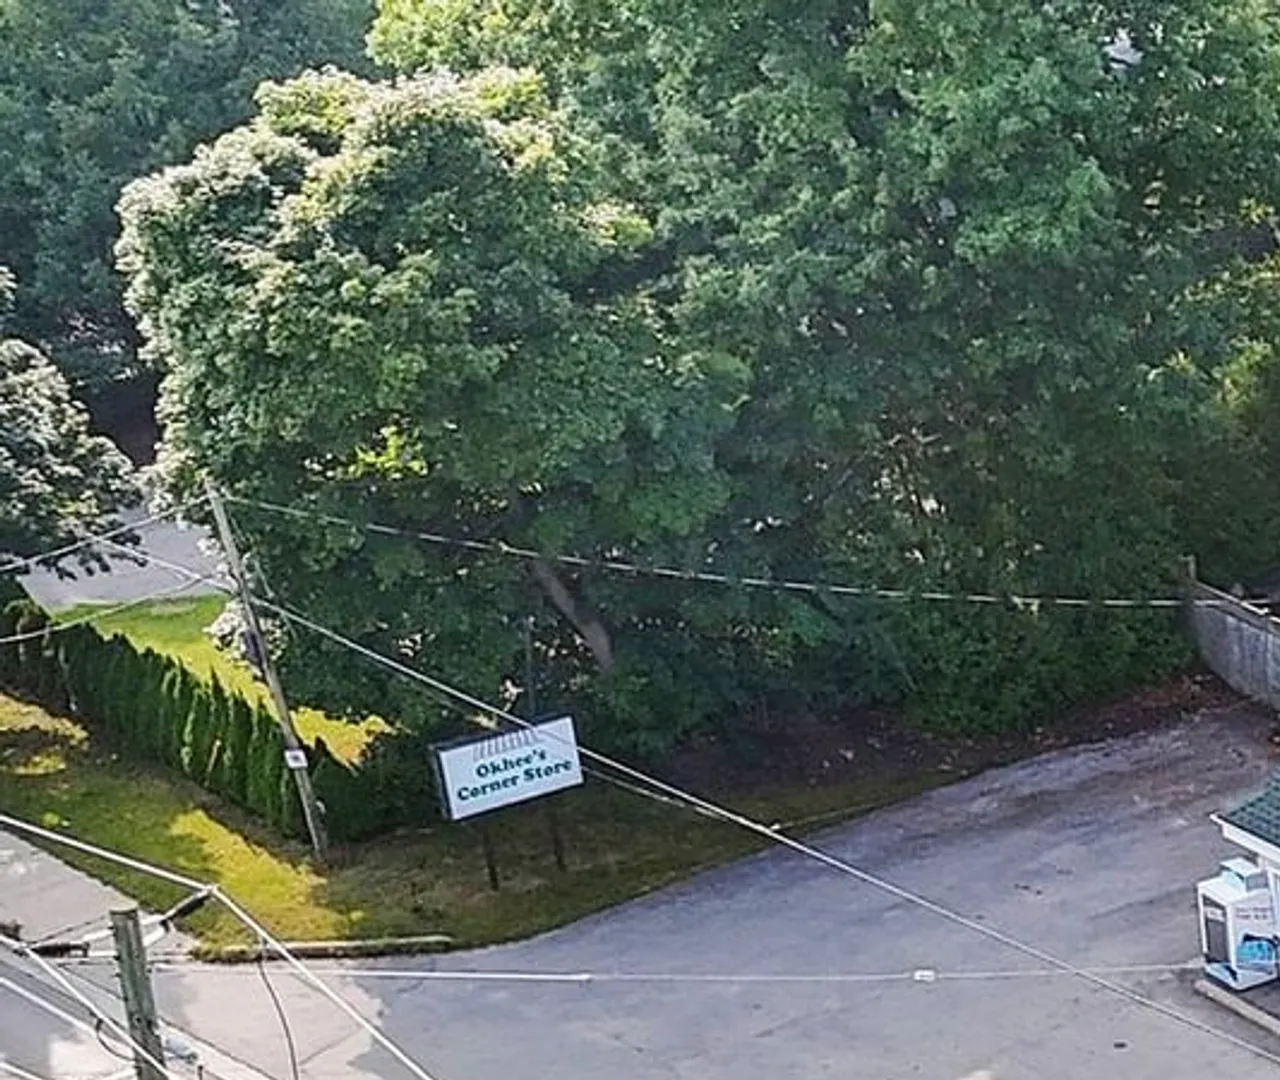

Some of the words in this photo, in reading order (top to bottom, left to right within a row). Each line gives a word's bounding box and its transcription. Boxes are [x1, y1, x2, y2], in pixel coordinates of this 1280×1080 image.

[457, 775, 520, 801] Corner
[523, 760, 573, 782] Store
[475, 749, 547, 778] Okhee's
